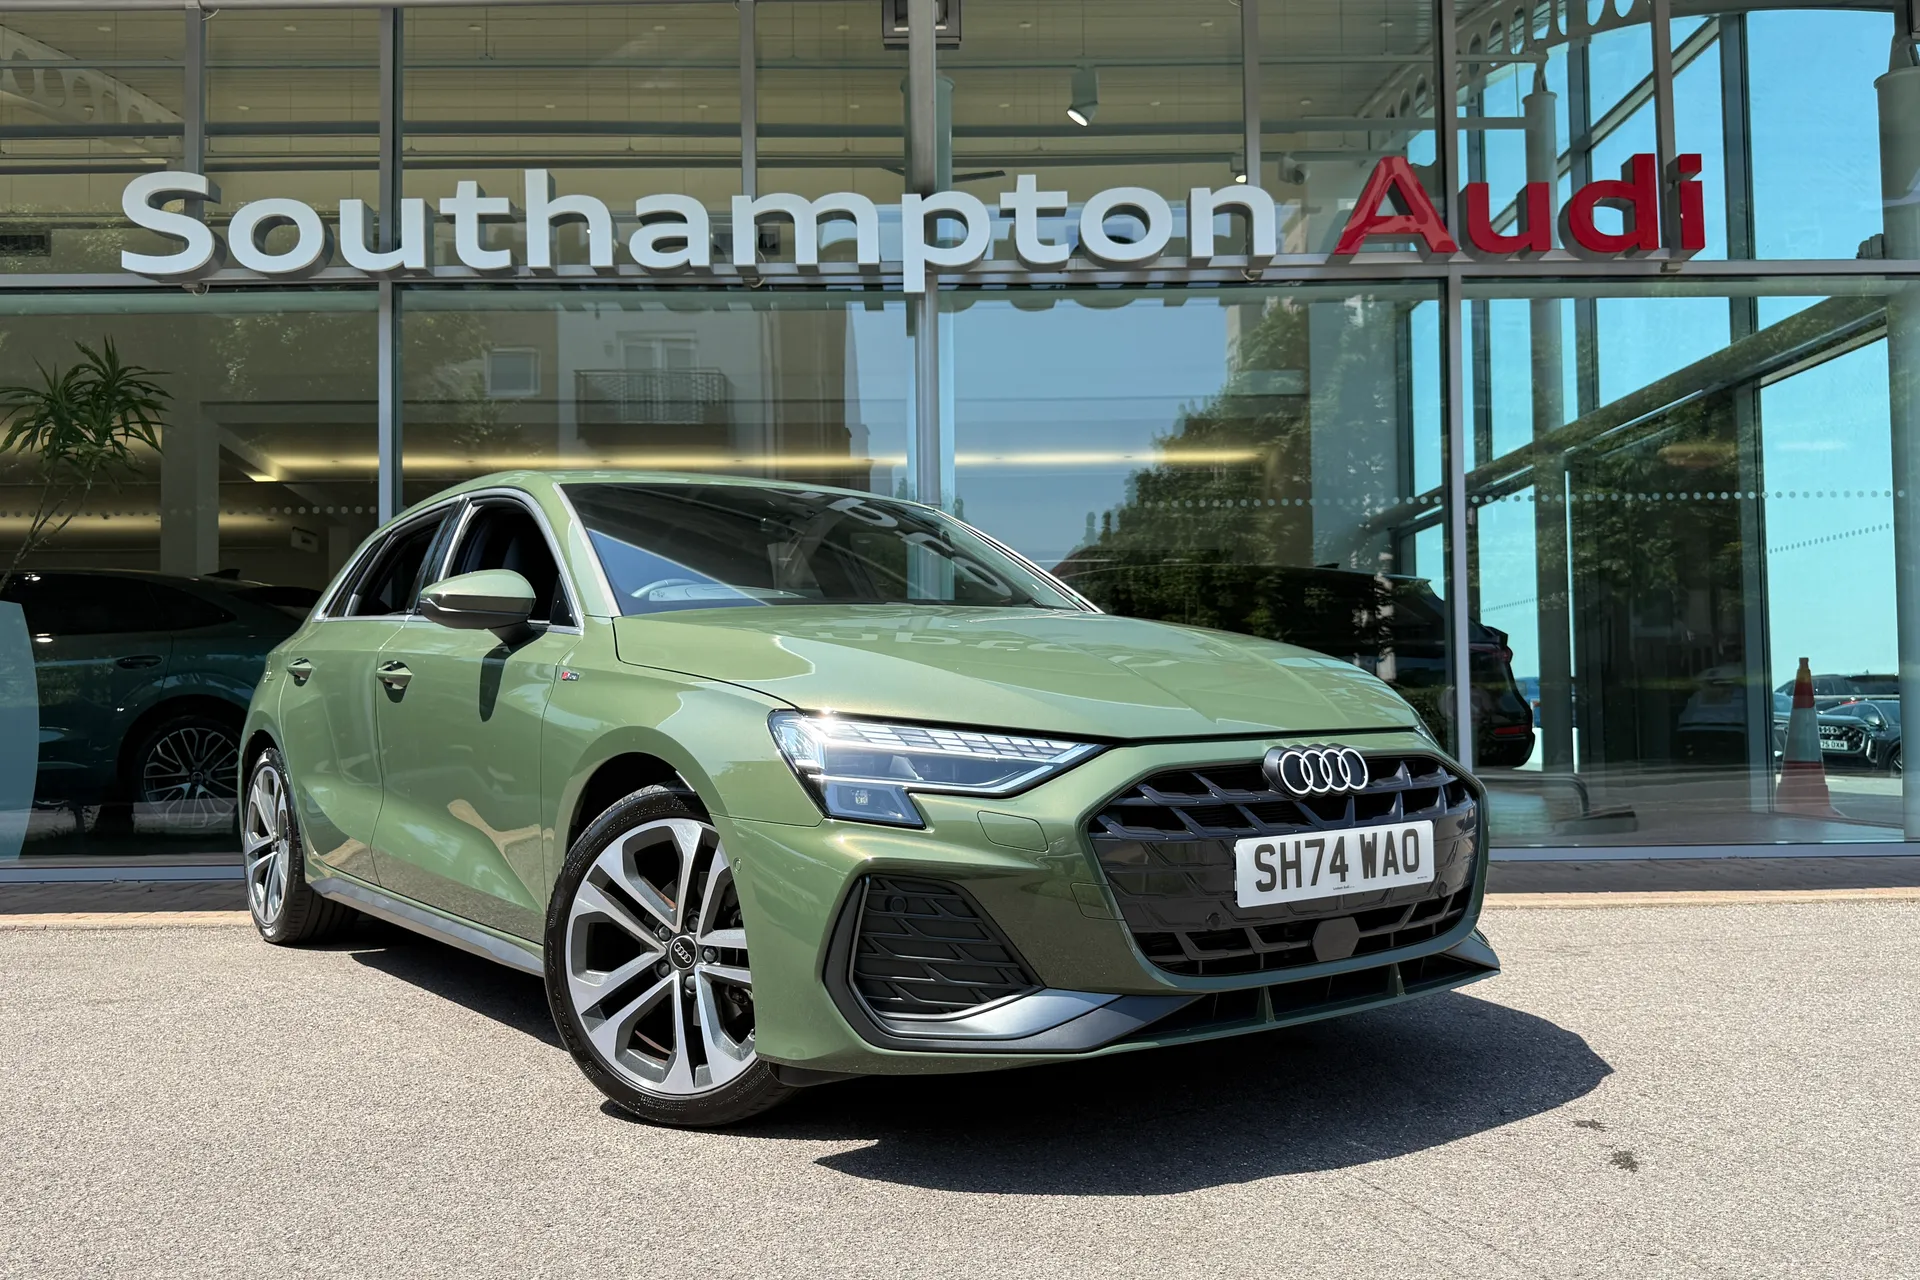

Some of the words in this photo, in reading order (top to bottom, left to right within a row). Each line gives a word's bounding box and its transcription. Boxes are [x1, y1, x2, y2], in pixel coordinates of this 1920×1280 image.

[121, 169, 1277, 293] Southampton
[1333, 153, 1705, 255] Audi
[1253, 836, 1349, 893] SH74
[1359, 828, 1420, 880] WAO
